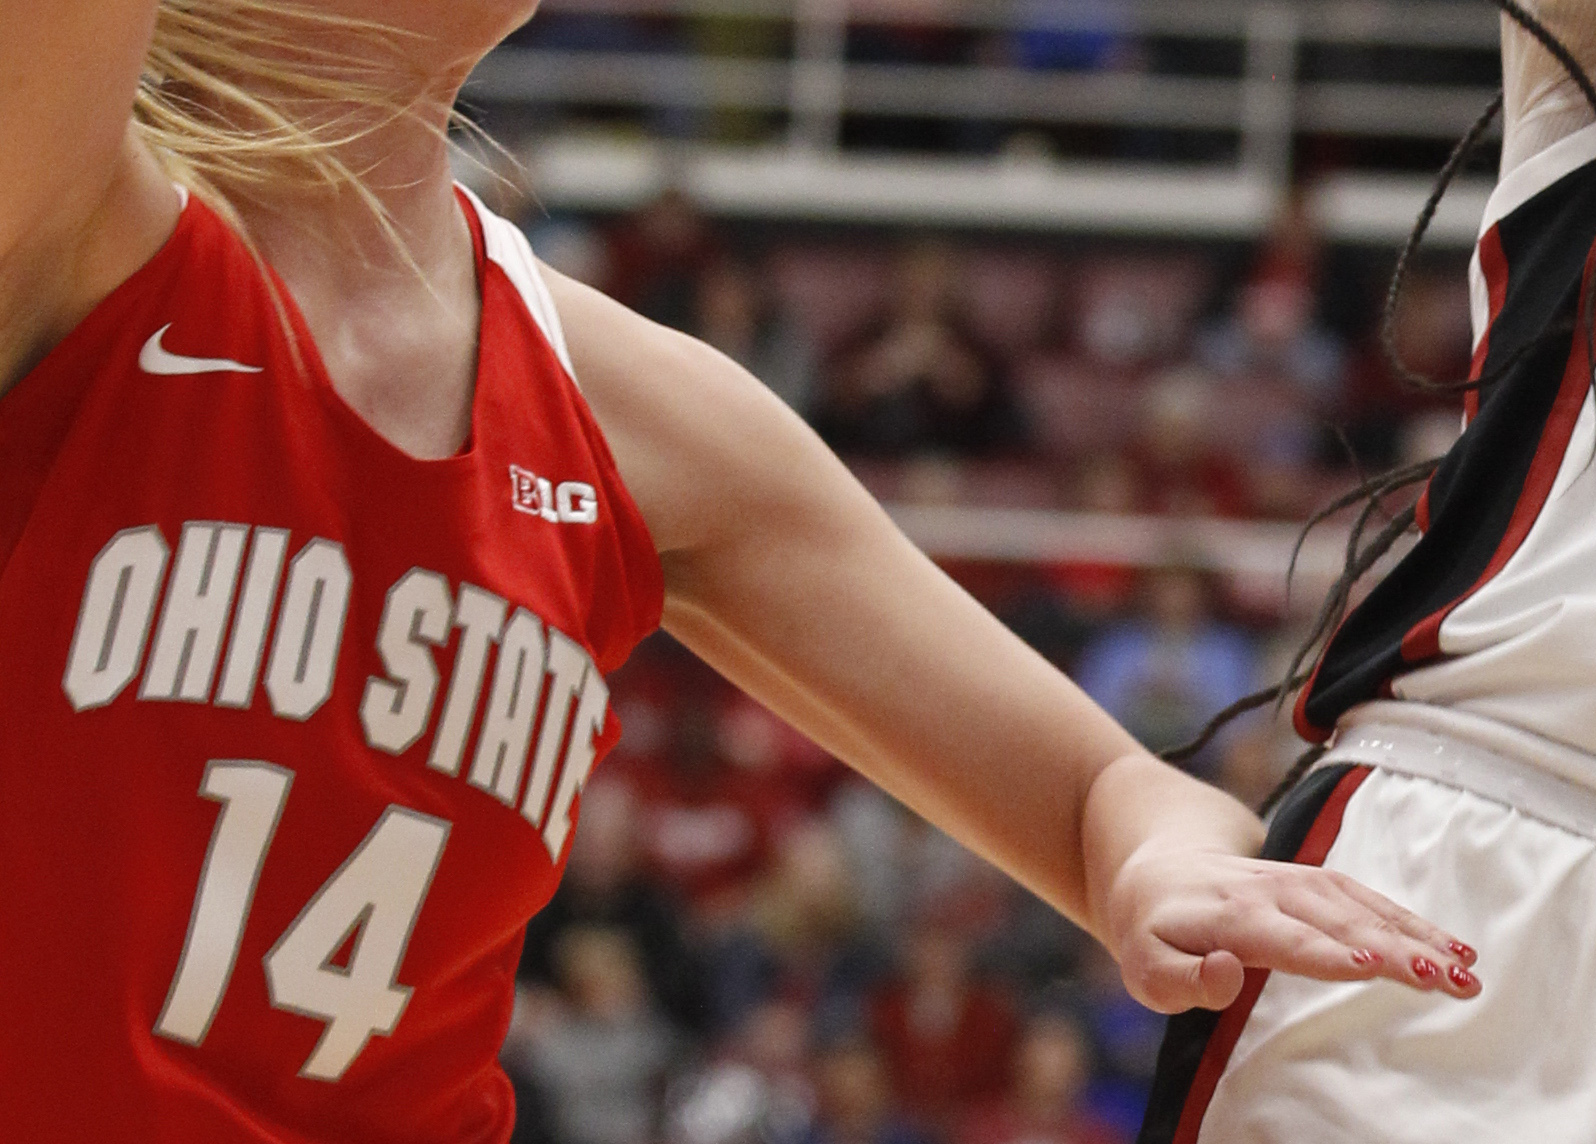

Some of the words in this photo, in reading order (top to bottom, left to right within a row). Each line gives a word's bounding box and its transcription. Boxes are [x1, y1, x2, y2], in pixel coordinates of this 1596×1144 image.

[62, 520, 354, 723] OHIO
[359, 566, 612, 866] STATE
[152, 758, 454, 1084] 14
